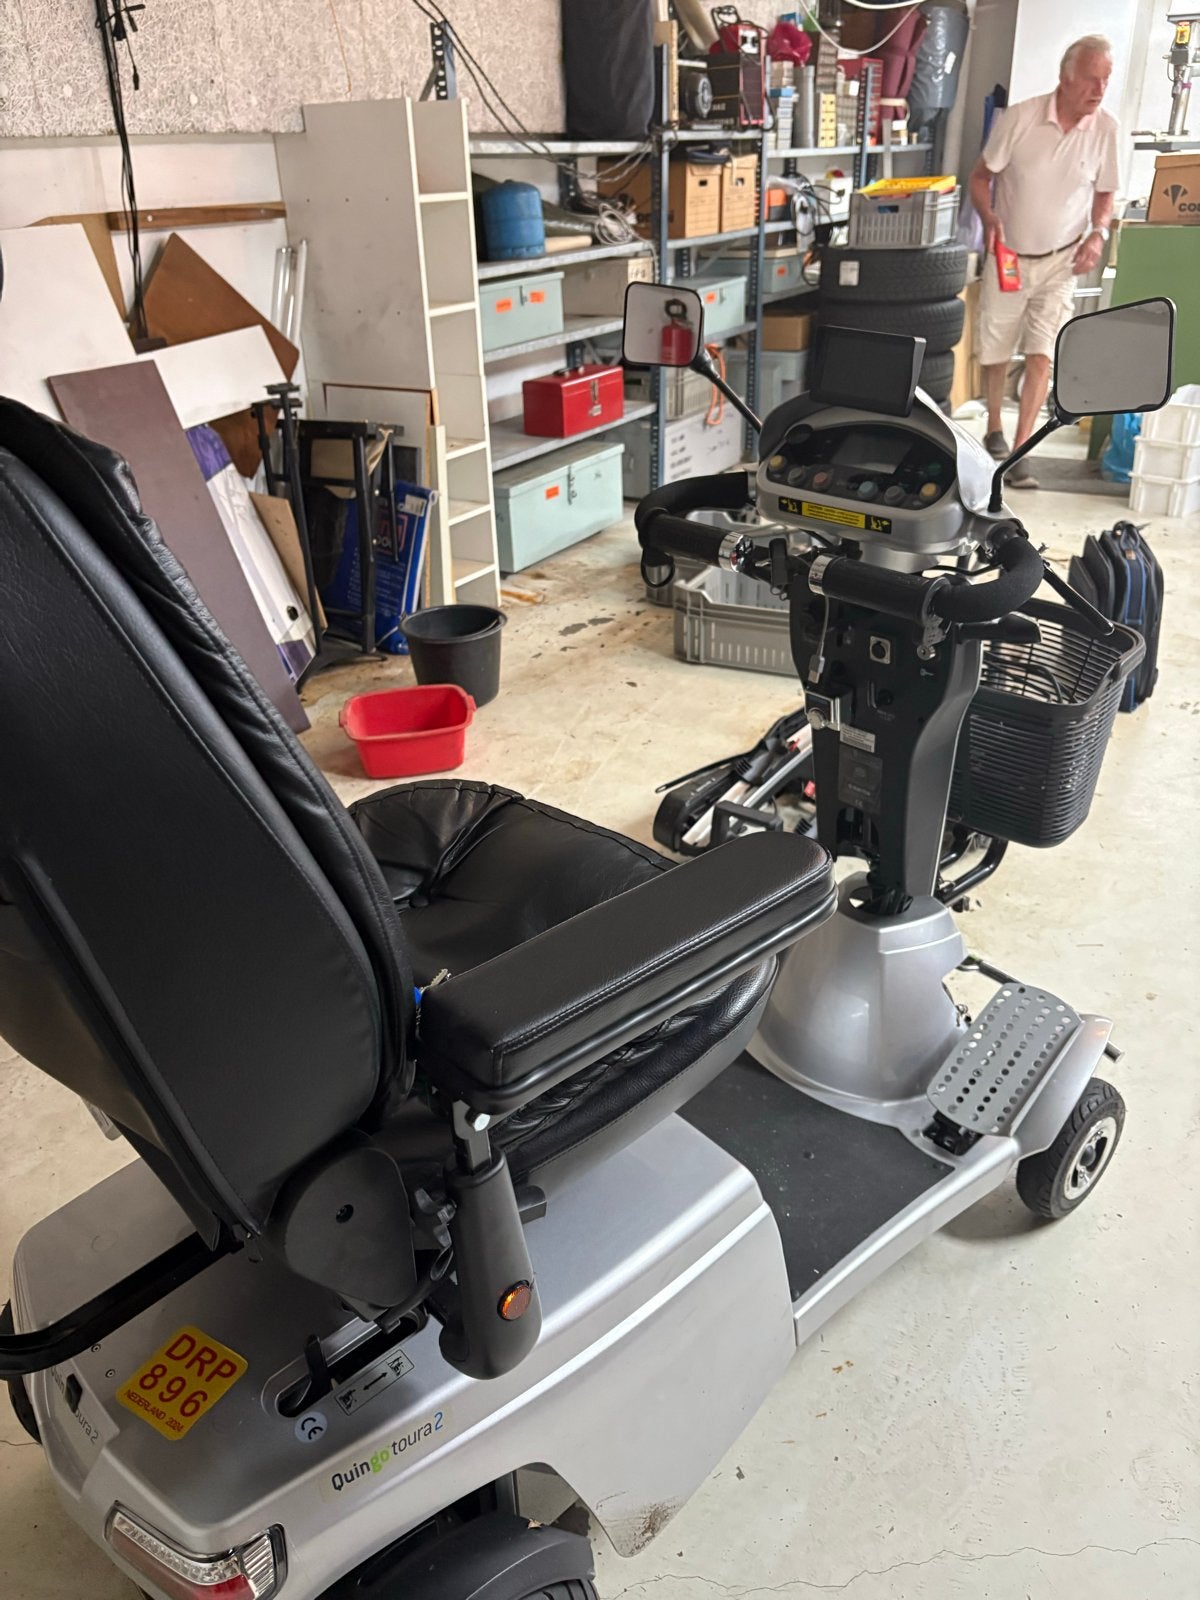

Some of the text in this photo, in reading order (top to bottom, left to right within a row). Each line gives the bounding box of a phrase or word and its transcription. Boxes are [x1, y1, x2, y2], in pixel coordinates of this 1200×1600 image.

[165, 1333, 237, 1382] DRP
[123, 1389, 167, 1420] NEDERLAND
[139, 1363, 208, 1418] 896
[331, 1448, 390, 1491] Quingo
[391, 1422, 432, 1455] toura
